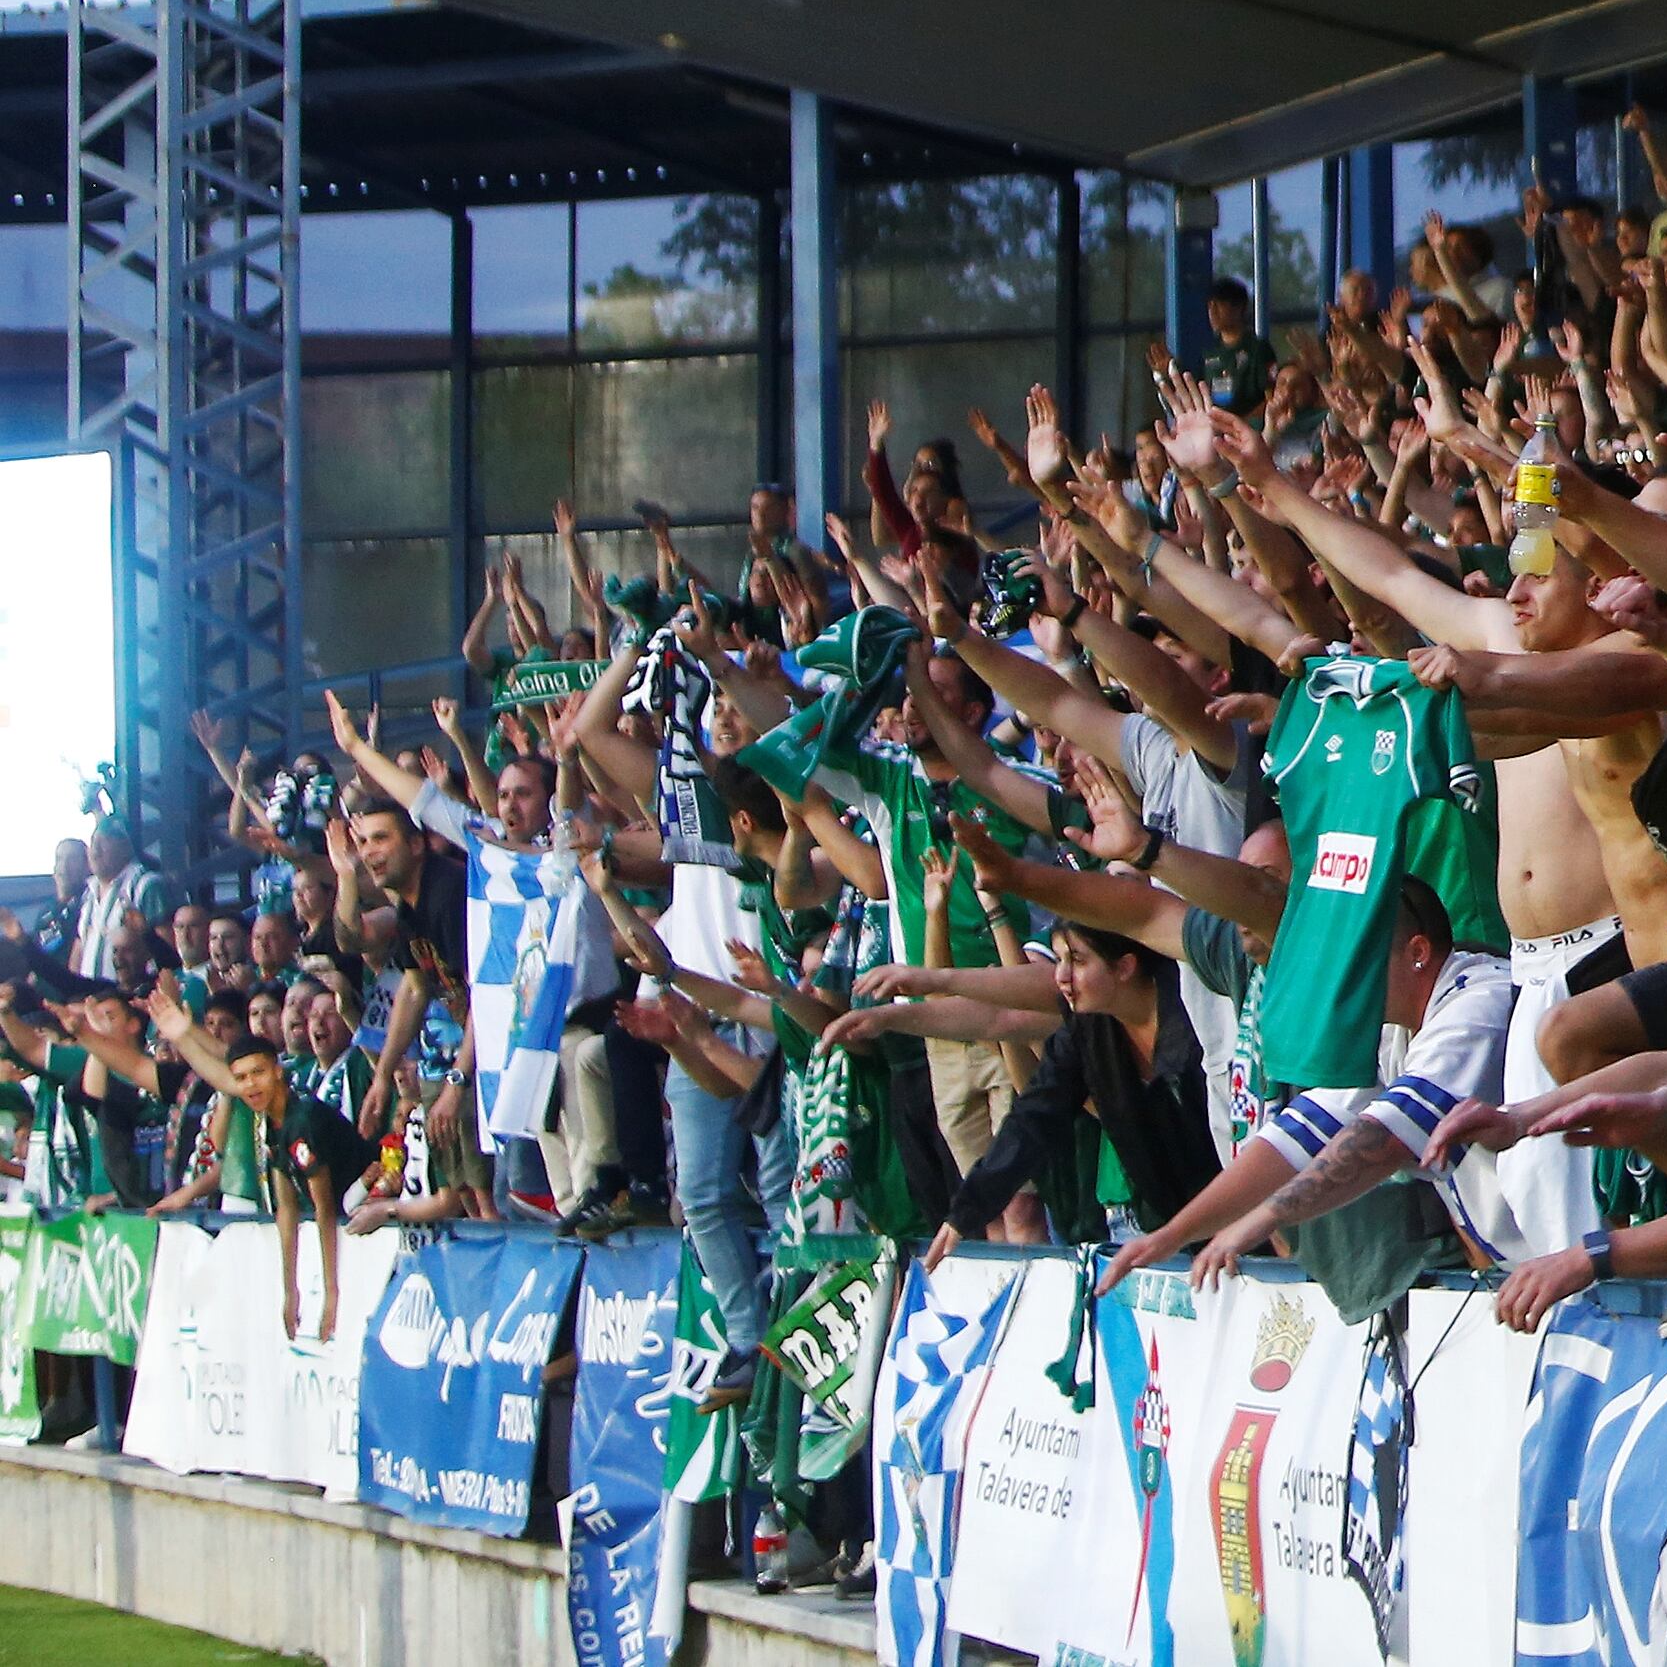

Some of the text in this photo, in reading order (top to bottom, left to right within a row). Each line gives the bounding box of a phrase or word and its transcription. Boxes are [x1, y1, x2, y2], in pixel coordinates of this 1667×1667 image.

[1551, 929, 1594, 950] FILA
[974, 1460, 1073, 1520] Talavera de
[605, 1539, 633, 1597] LA
